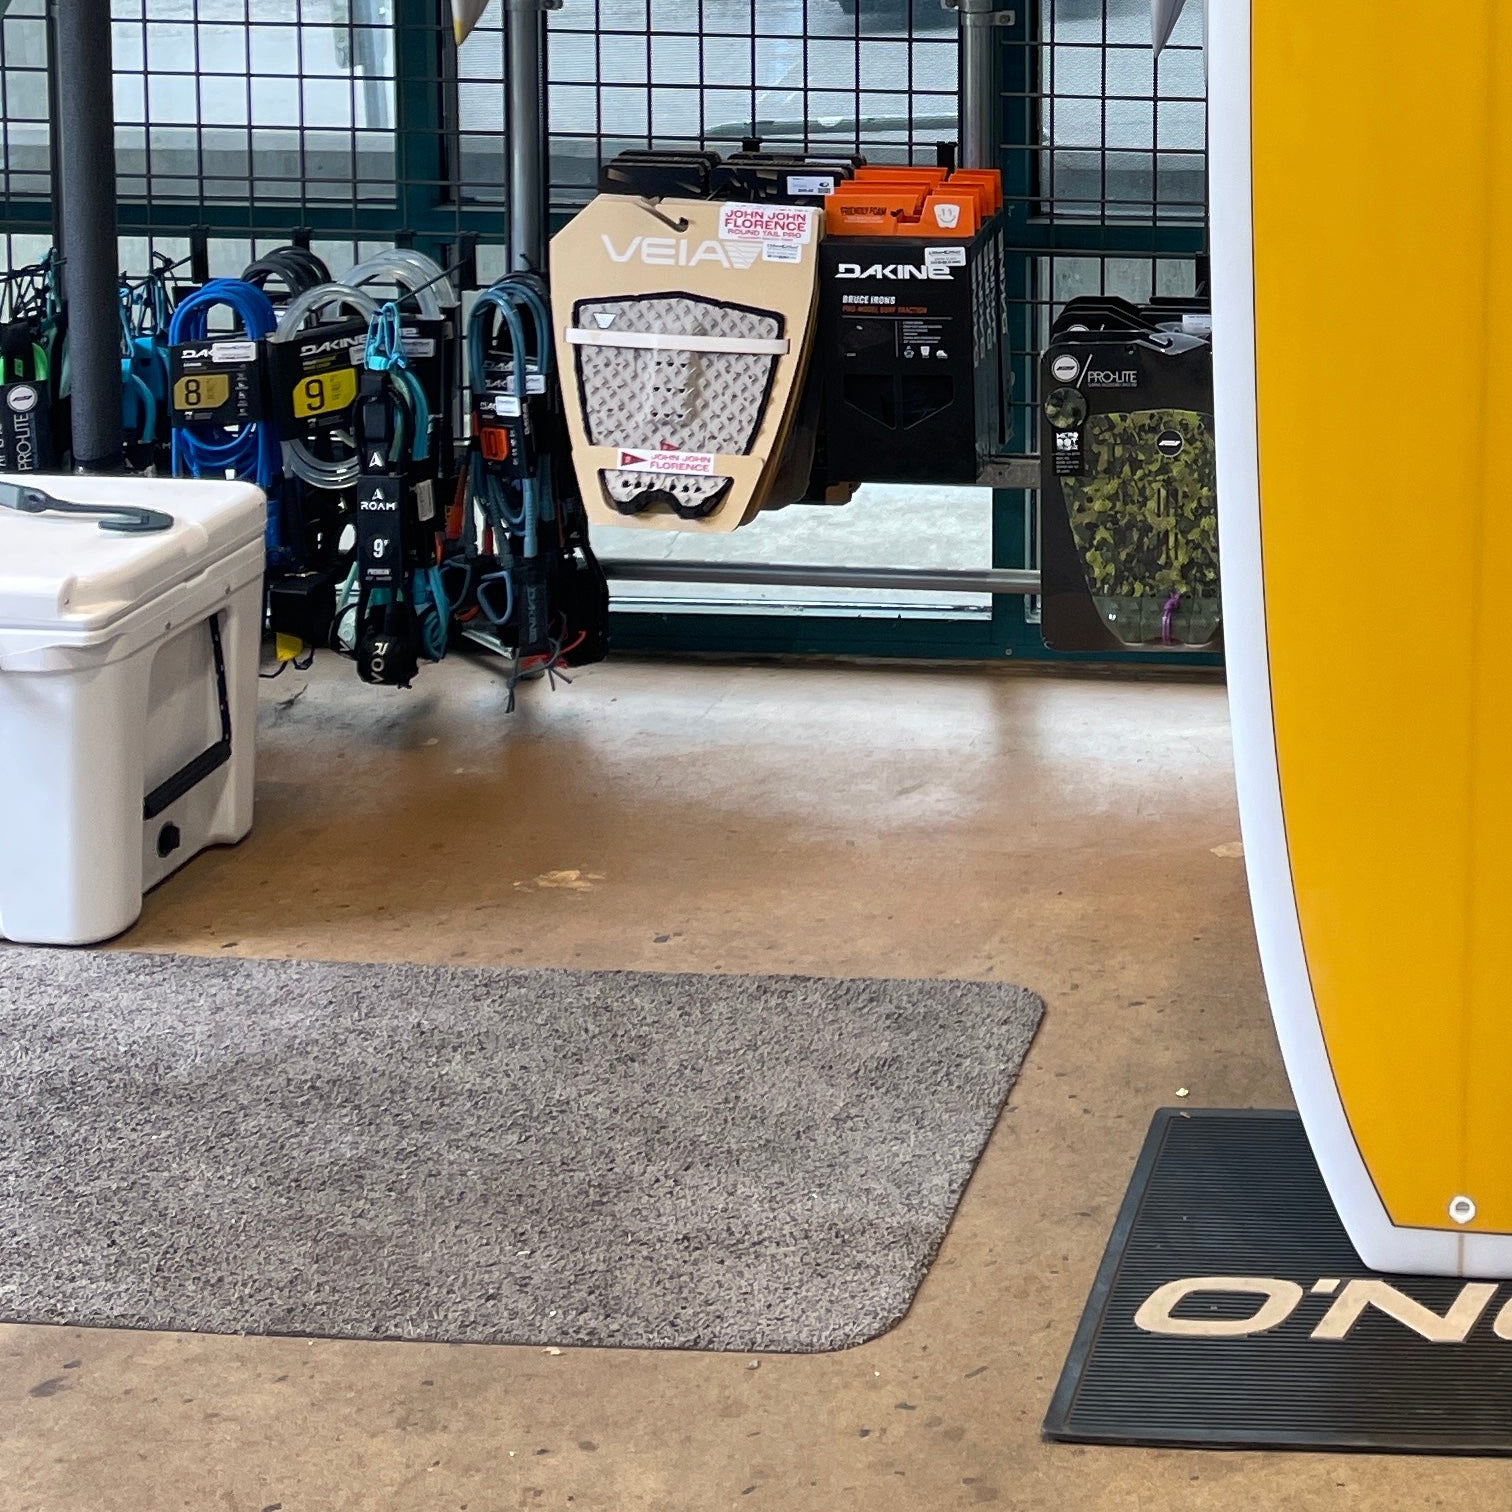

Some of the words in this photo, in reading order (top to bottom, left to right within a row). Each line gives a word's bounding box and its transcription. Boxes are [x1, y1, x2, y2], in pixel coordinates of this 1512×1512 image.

[725, 209, 764, 220] JOHN
[767, 211, 806, 222] JOHN
[724, 218, 806, 232] FLORENCE
[727, 228, 760, 237] ROUND
[762, 230, 781, 238] TAIL
[782, 231, 802, 239] PRO
[601, 234, 733, 269] VEIA
[834, 263, 955, 280] DAKINE
[842, 294, 869, 304] BRUCE
[870, 295, 896, 305] IRONS
[1087, 370, 1138, 383] PRO-LITE
[184, 378, 201, 406] 8
[305, 379, 325, 411] 9
[13, 412, 34, 472] PRO-LITE
[651, 453, 679, 461] JOHN
[681, 455, 711, 463] JOHN
[649, 461, 710, 472] FLORENCE
[360, 501, 396, 511] ROAM
